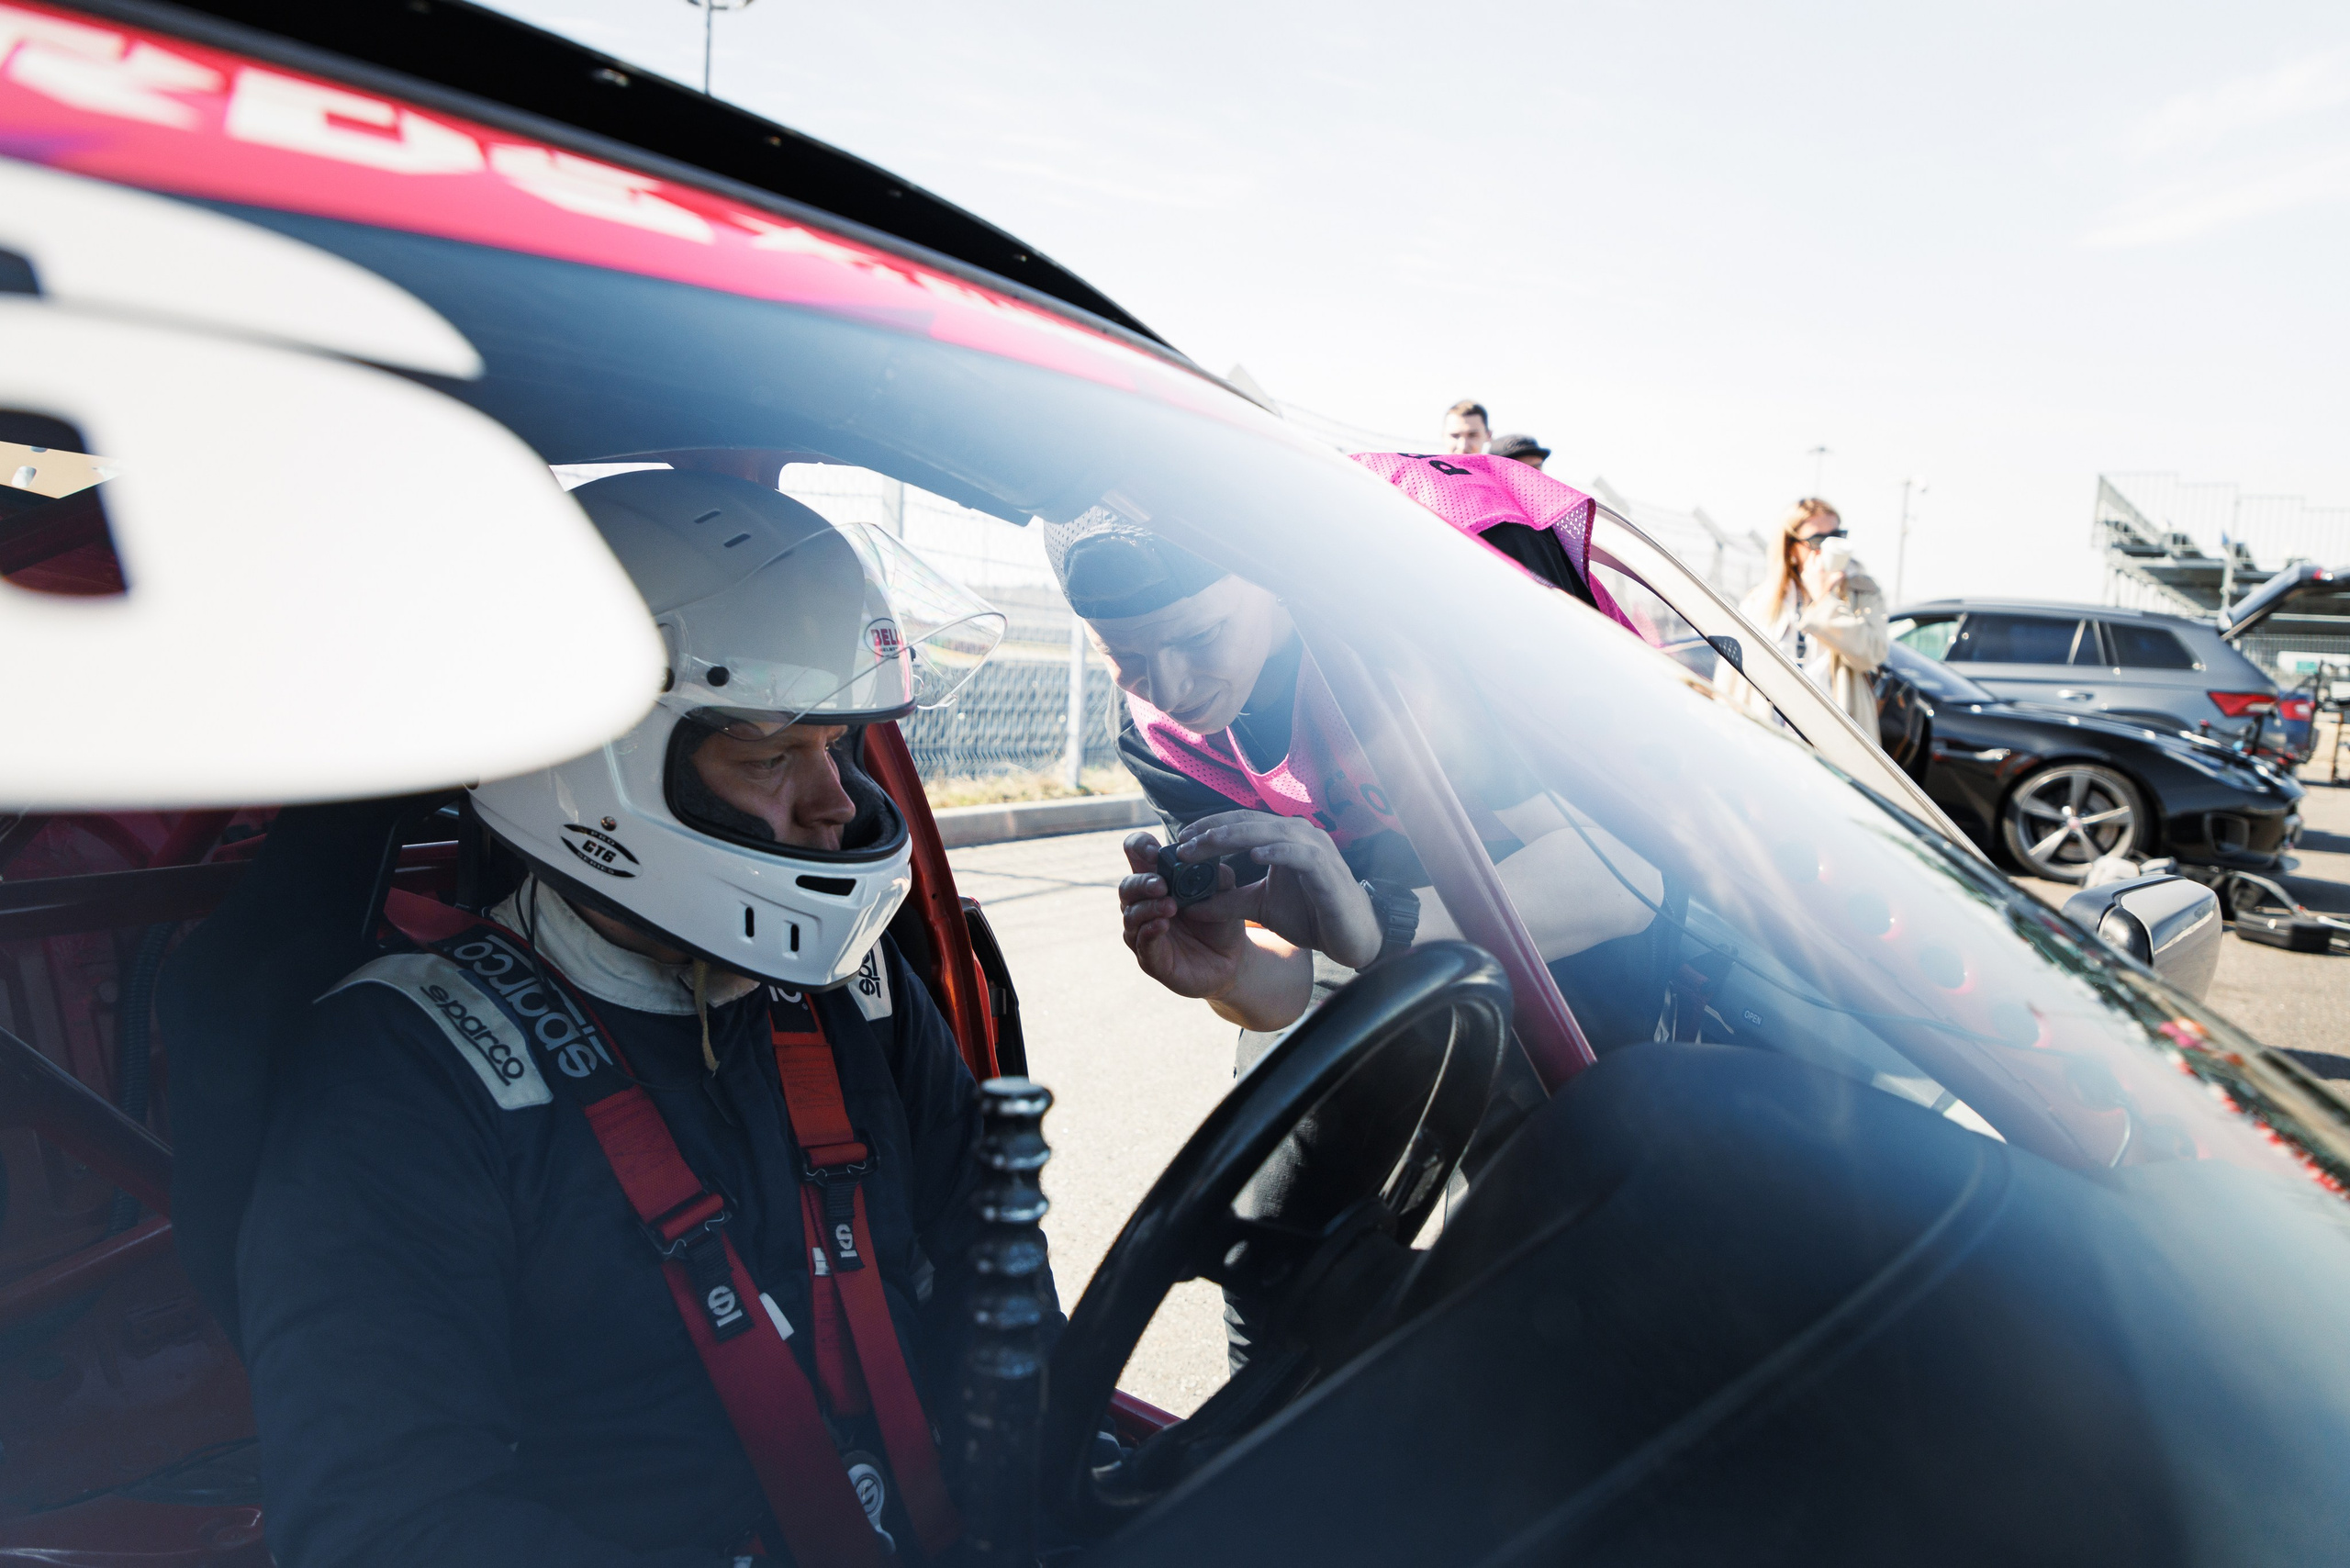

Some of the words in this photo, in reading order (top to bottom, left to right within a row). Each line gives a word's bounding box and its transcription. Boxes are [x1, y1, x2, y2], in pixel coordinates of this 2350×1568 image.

[590, 831, 615, 846] PRO
[582, 839, 616, 863] GT6
[576, 852, 615, 874] SERIES
[453, 936, 601, 1078] sparco
[1744, 1010, 1762, 1025] OPEN
[422, 984, 524, 1084] sparco
